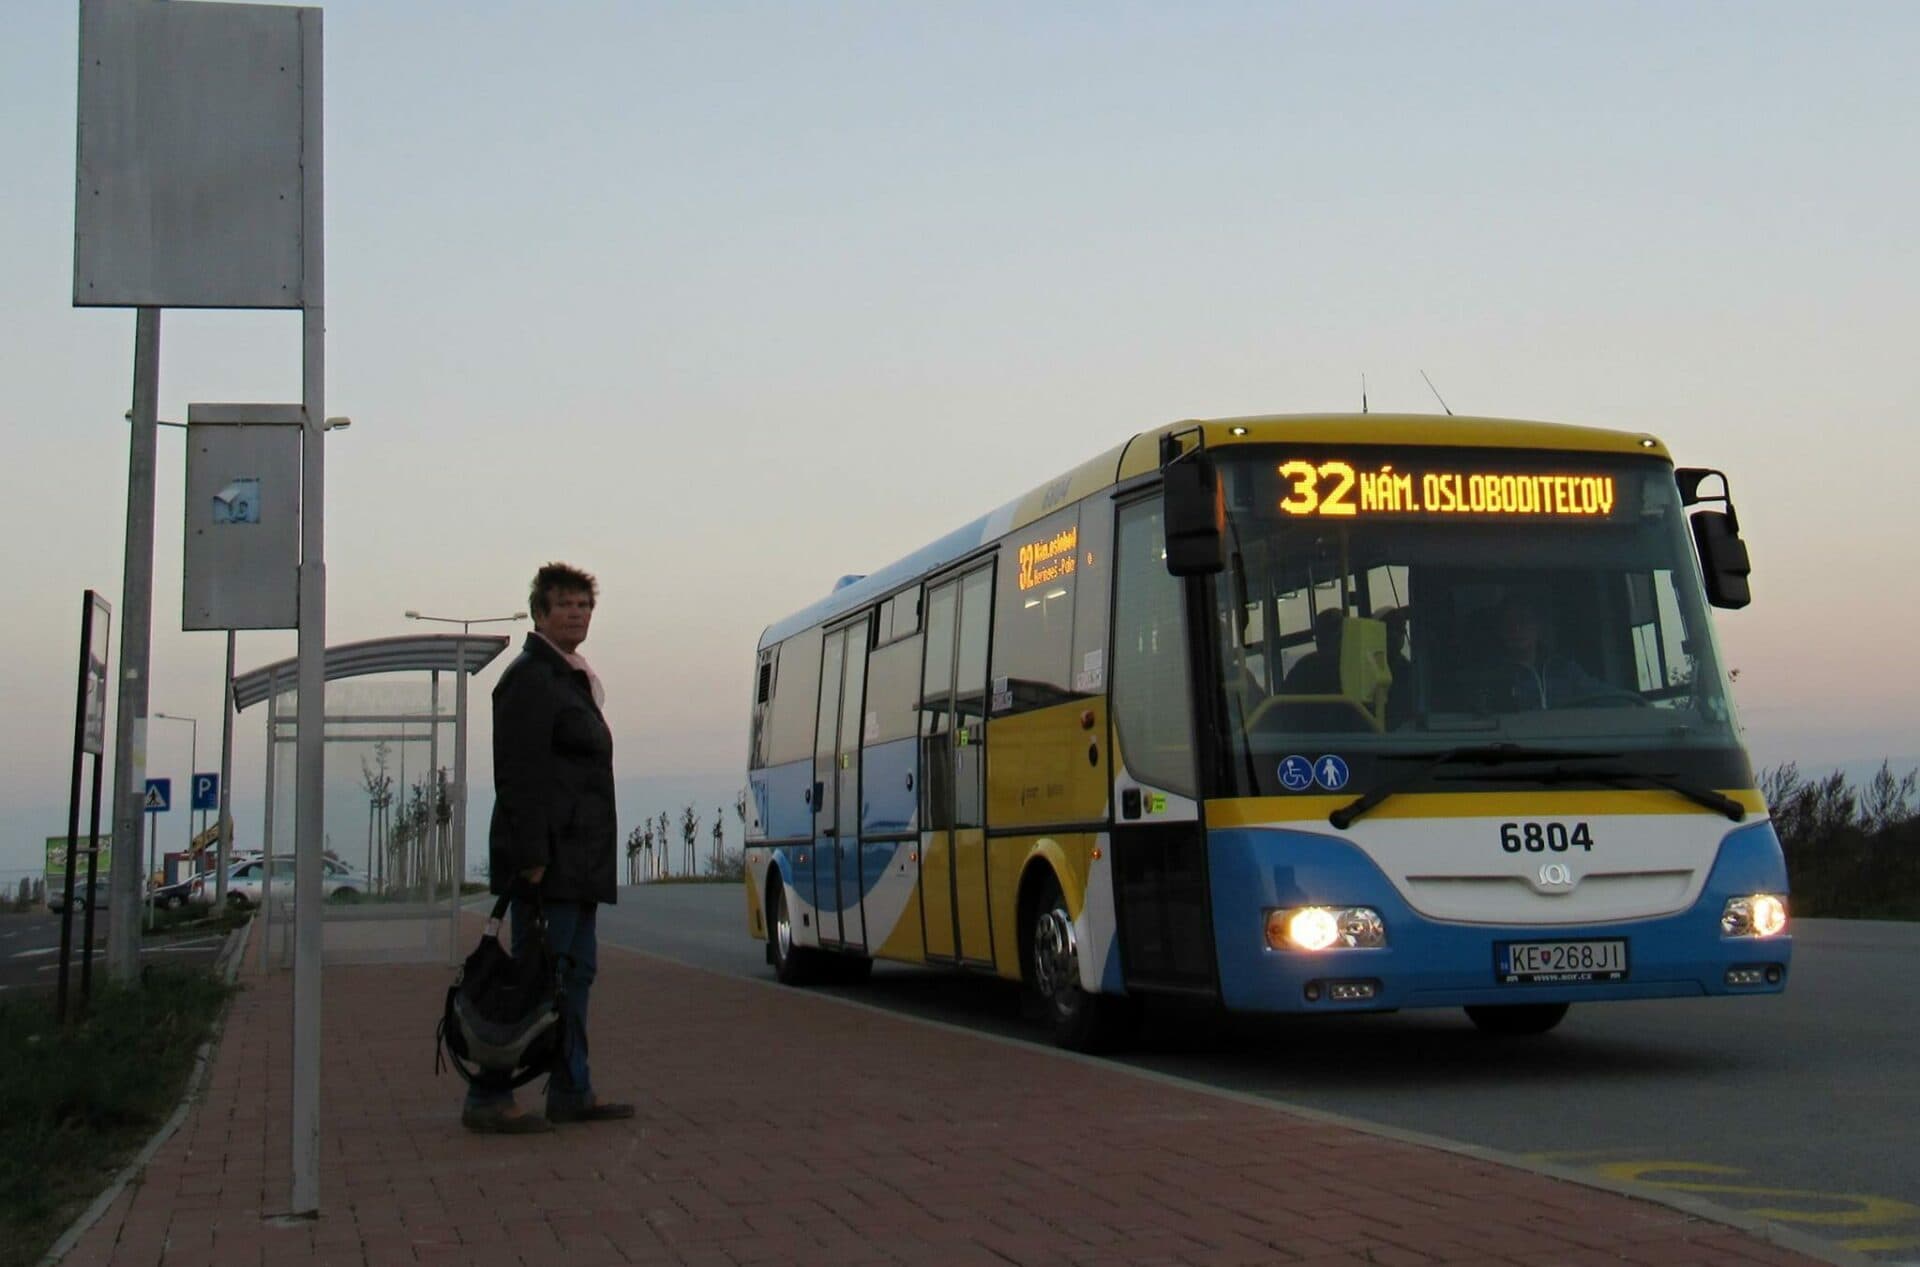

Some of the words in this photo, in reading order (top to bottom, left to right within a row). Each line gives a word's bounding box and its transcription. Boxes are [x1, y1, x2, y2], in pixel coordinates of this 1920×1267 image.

[1279, 460, 1357, 515] 32
[1360, 466, 1420, 512] NÁM.
[1424, 474, 1615, 515] OSLOBODITEĽOV
[1019, 544, 1034, 590] 32
[198, 777, 211, 799] P
[1500, 822, 1594, 853] 6804
